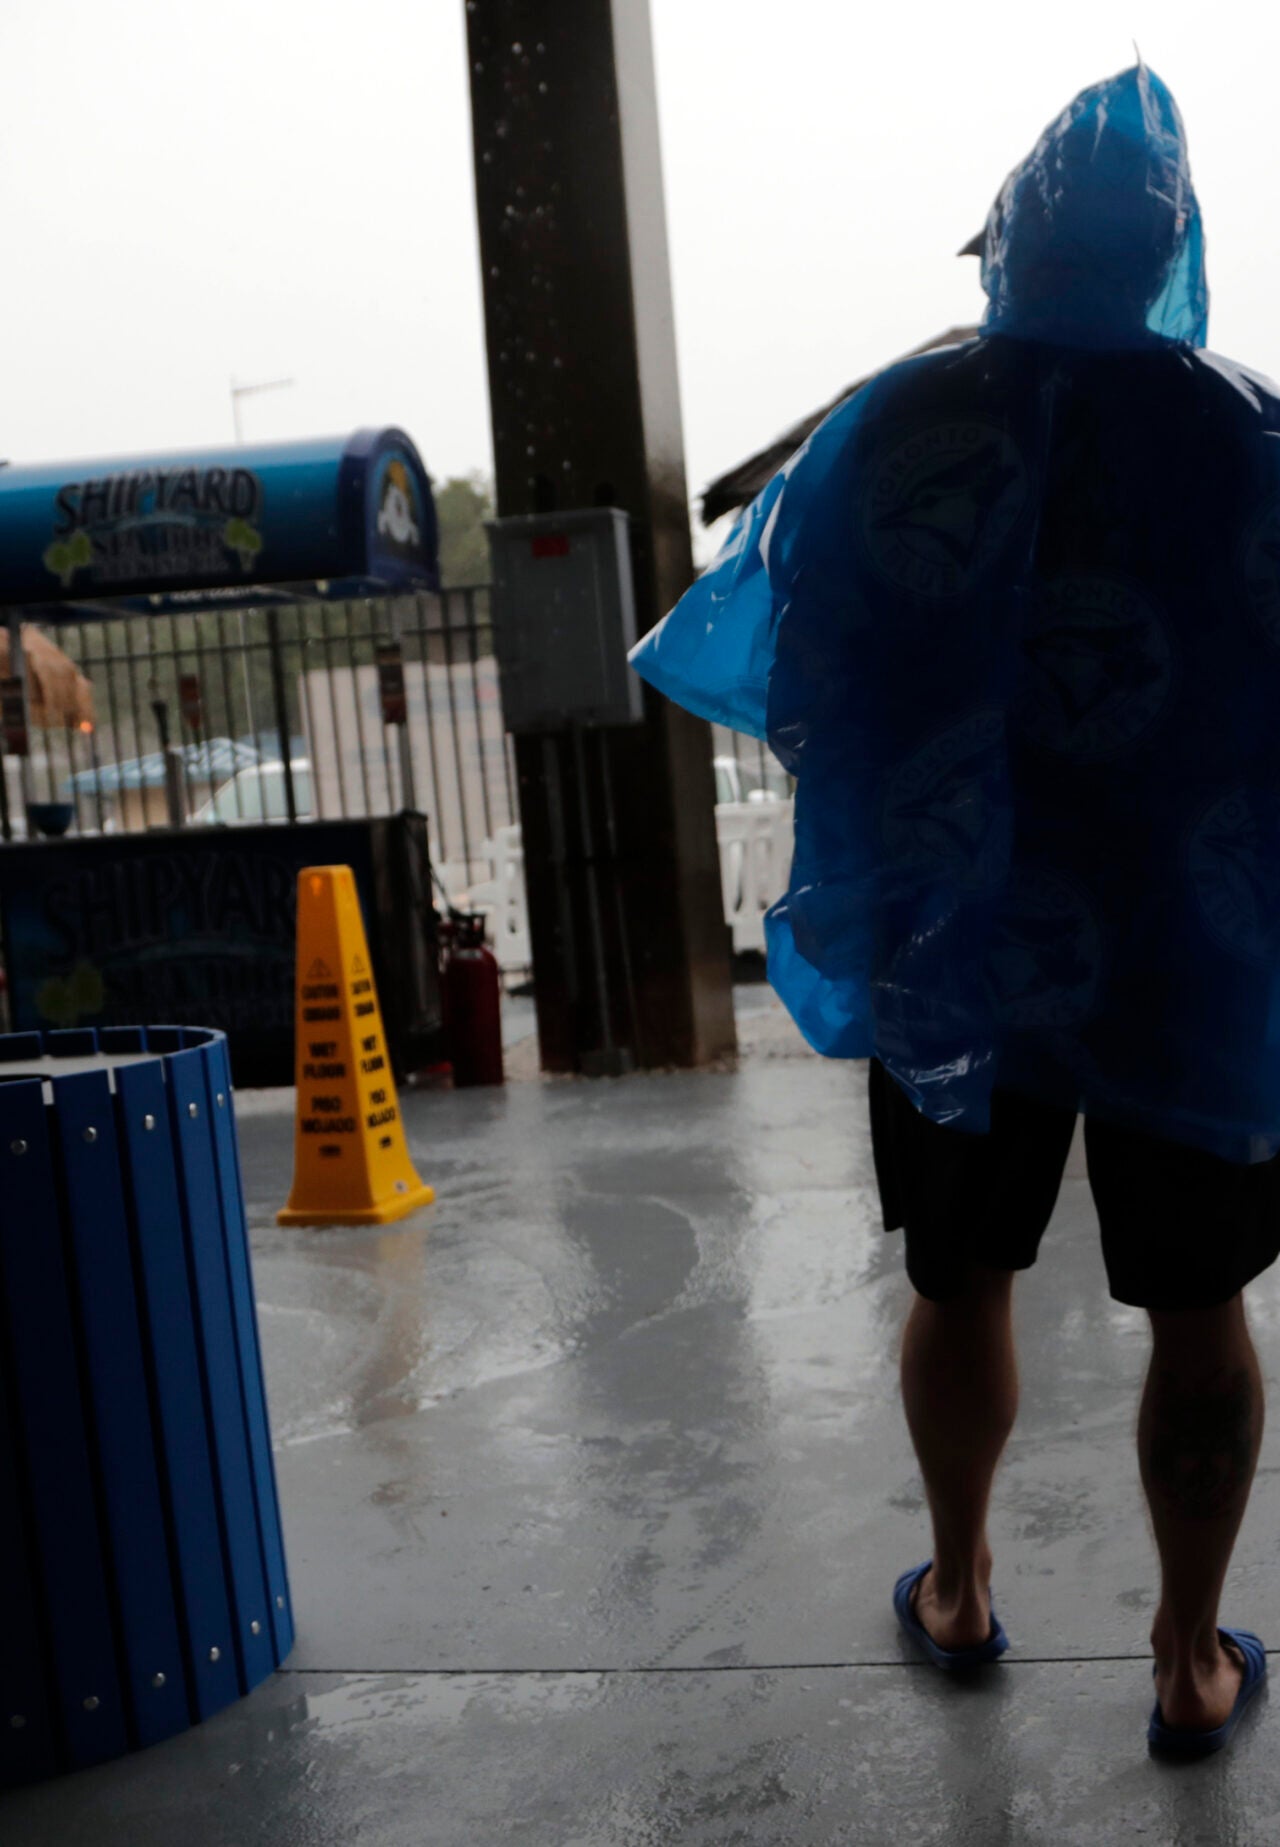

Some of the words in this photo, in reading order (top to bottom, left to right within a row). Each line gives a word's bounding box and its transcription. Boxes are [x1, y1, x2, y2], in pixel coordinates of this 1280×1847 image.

[54, 468, 259, 536] SHIPYARD
[42, 851, 296, 967] SHIPYAR
[309, 1042, 337, 1057] WET
